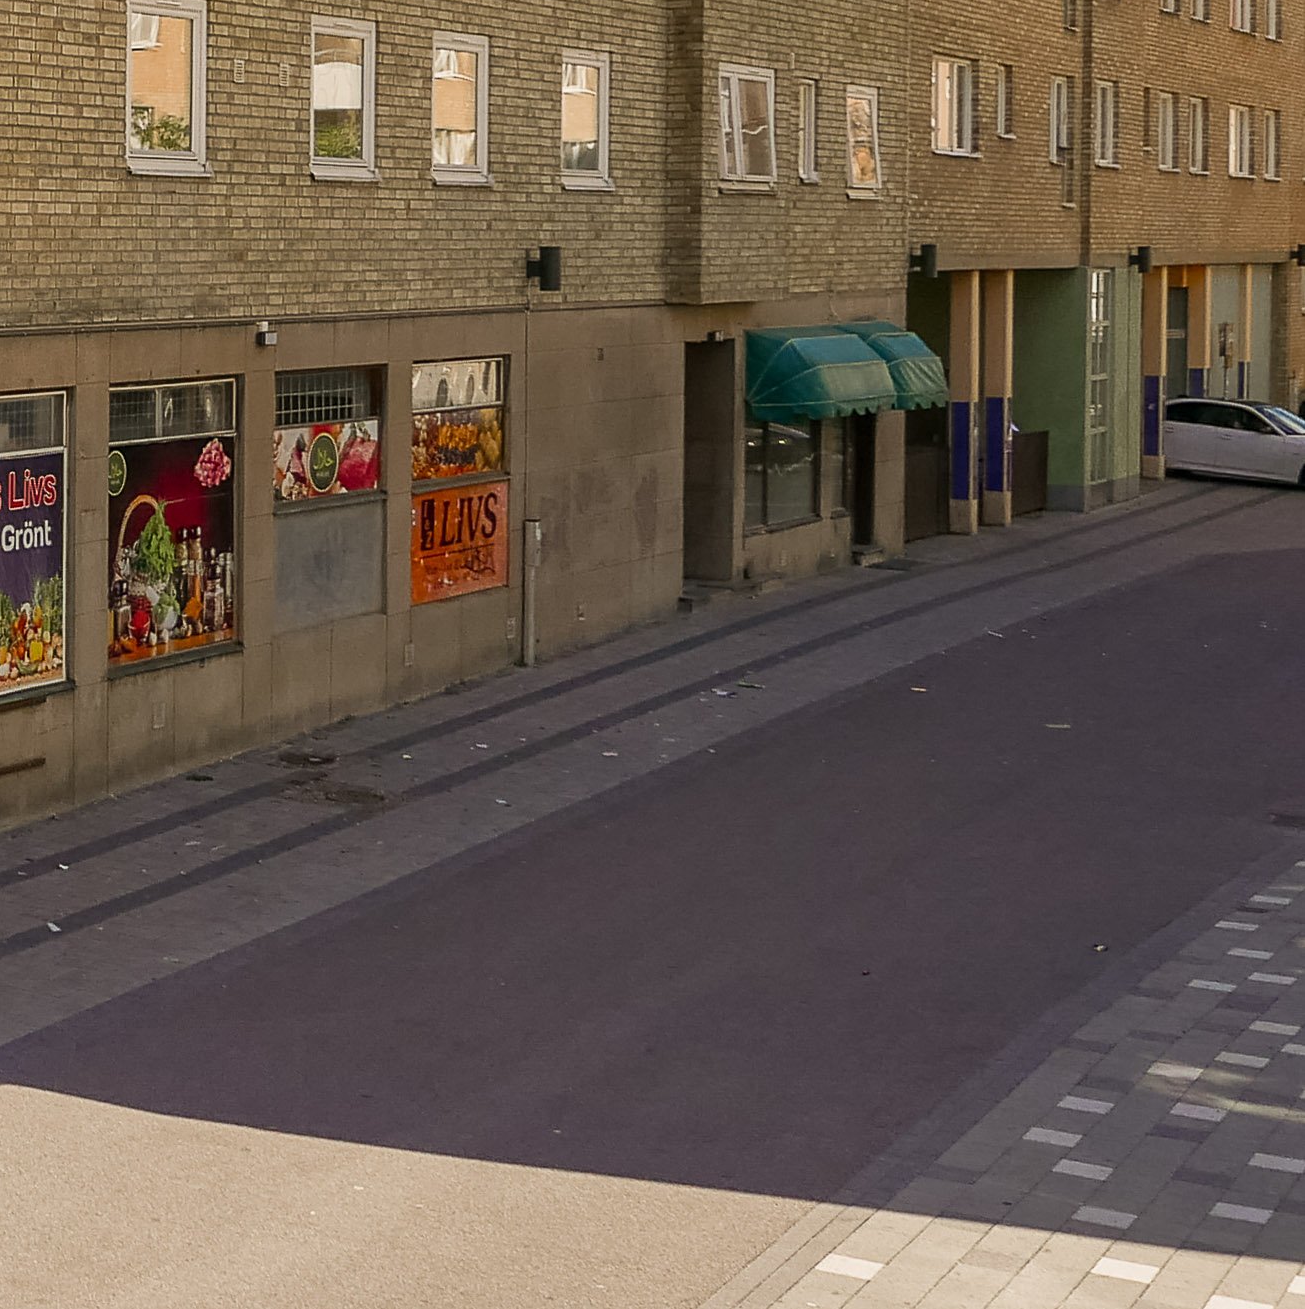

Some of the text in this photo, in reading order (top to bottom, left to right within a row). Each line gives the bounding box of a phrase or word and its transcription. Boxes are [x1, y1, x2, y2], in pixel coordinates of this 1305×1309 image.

[8, 469, 57, 510] Livs
[1, 520, 52, 552] Grönt
[440, 492, 498, 547] LIVS
